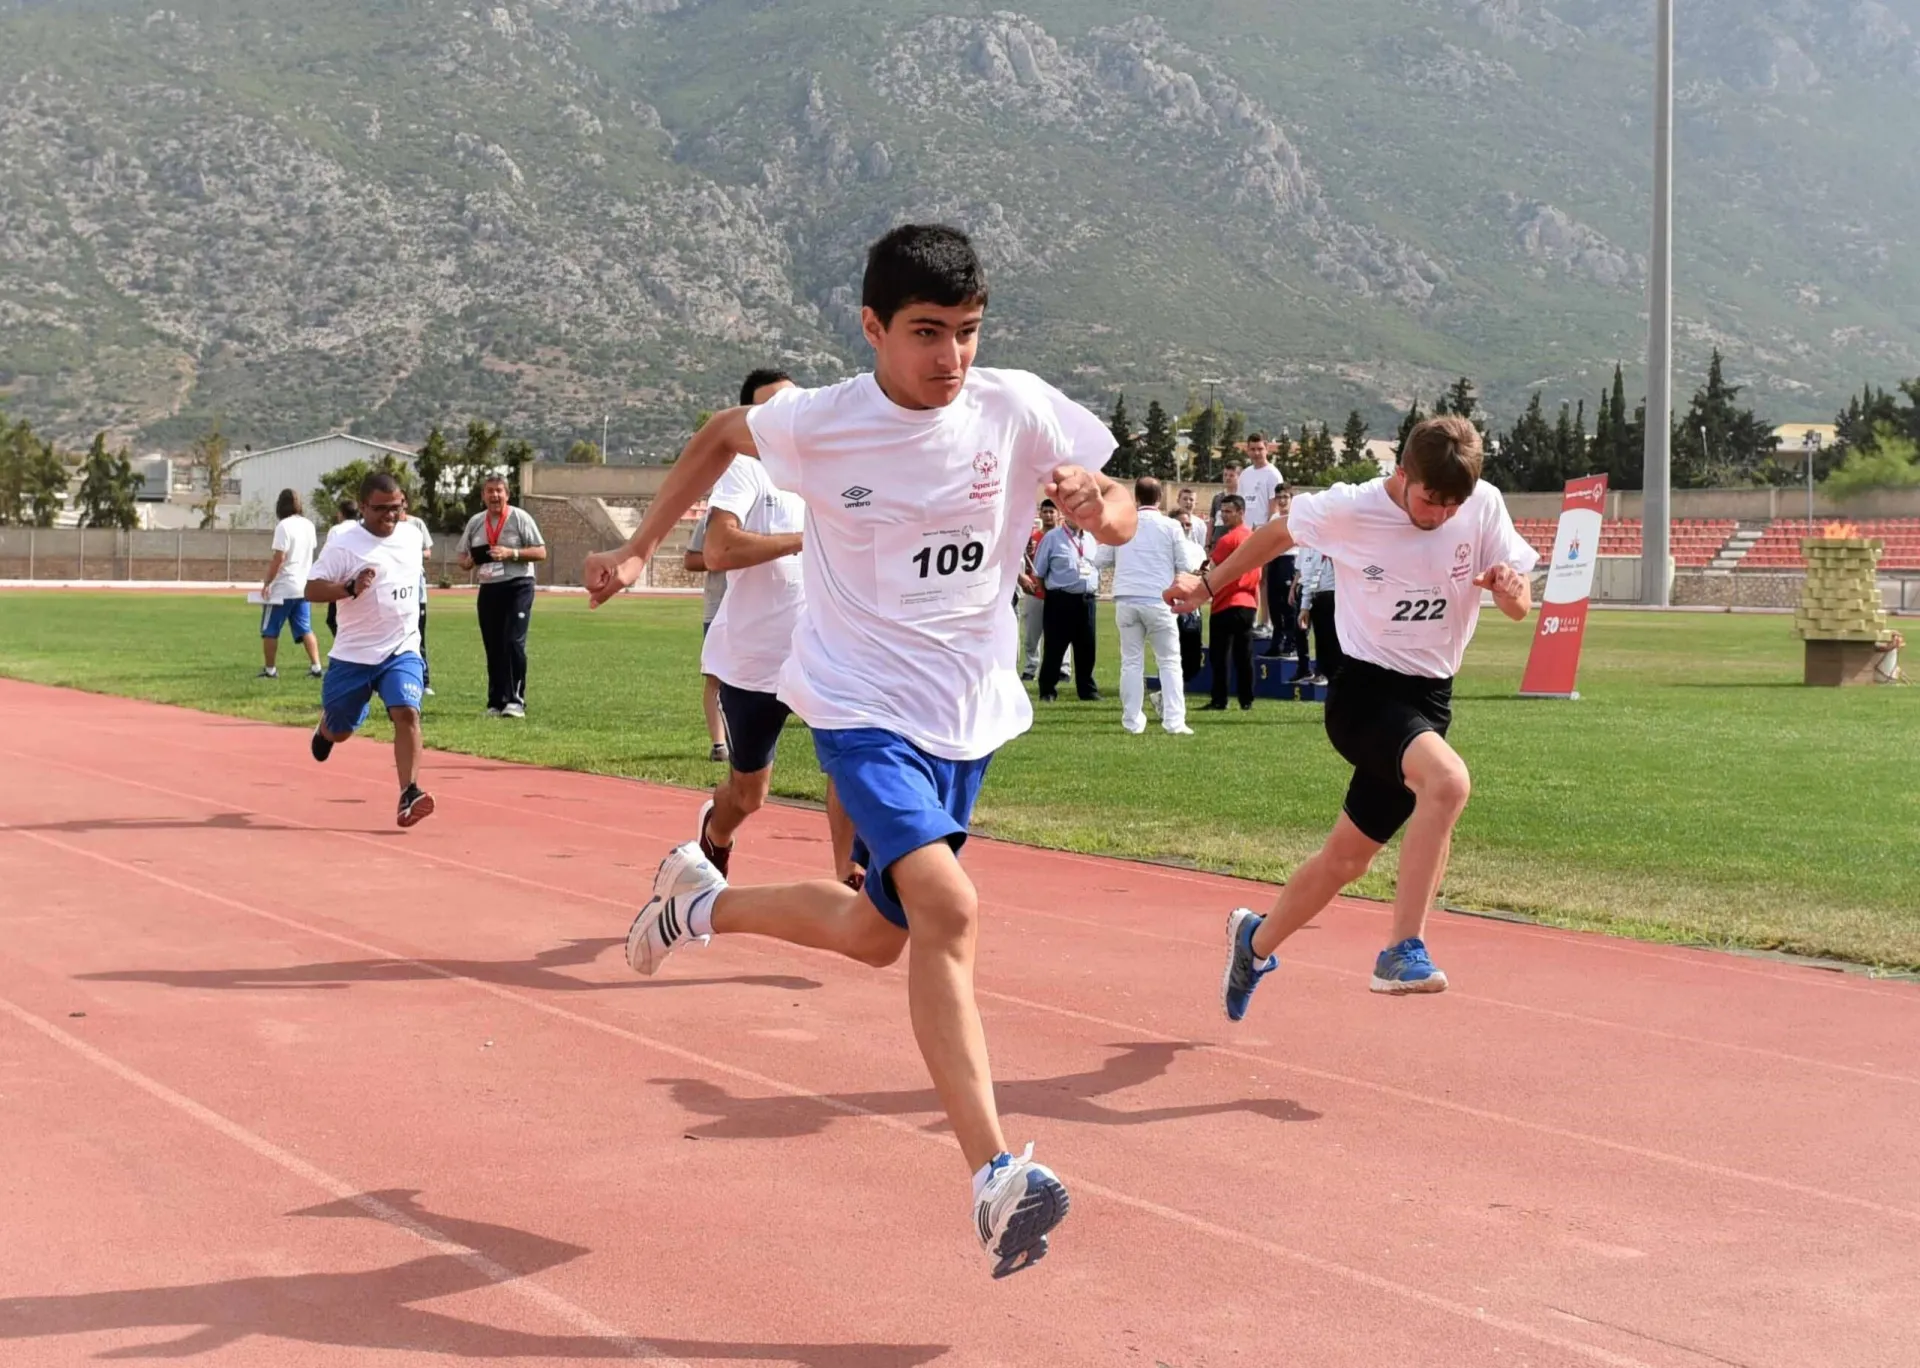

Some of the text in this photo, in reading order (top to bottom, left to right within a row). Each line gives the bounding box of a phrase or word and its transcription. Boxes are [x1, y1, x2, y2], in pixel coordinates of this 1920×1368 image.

[972, 478, 1001, 491] Special
[844, 500, 871, 508] umbro
[912, 541, 984, 578] 109
[391, 586, 413, 601] 107
[1391, 598, 1447, 621] 222
[1541, 616, 1560, 636] 50
[1261, 664, 1268, 680] 3
[1294, 686, 1301, 701] 5
